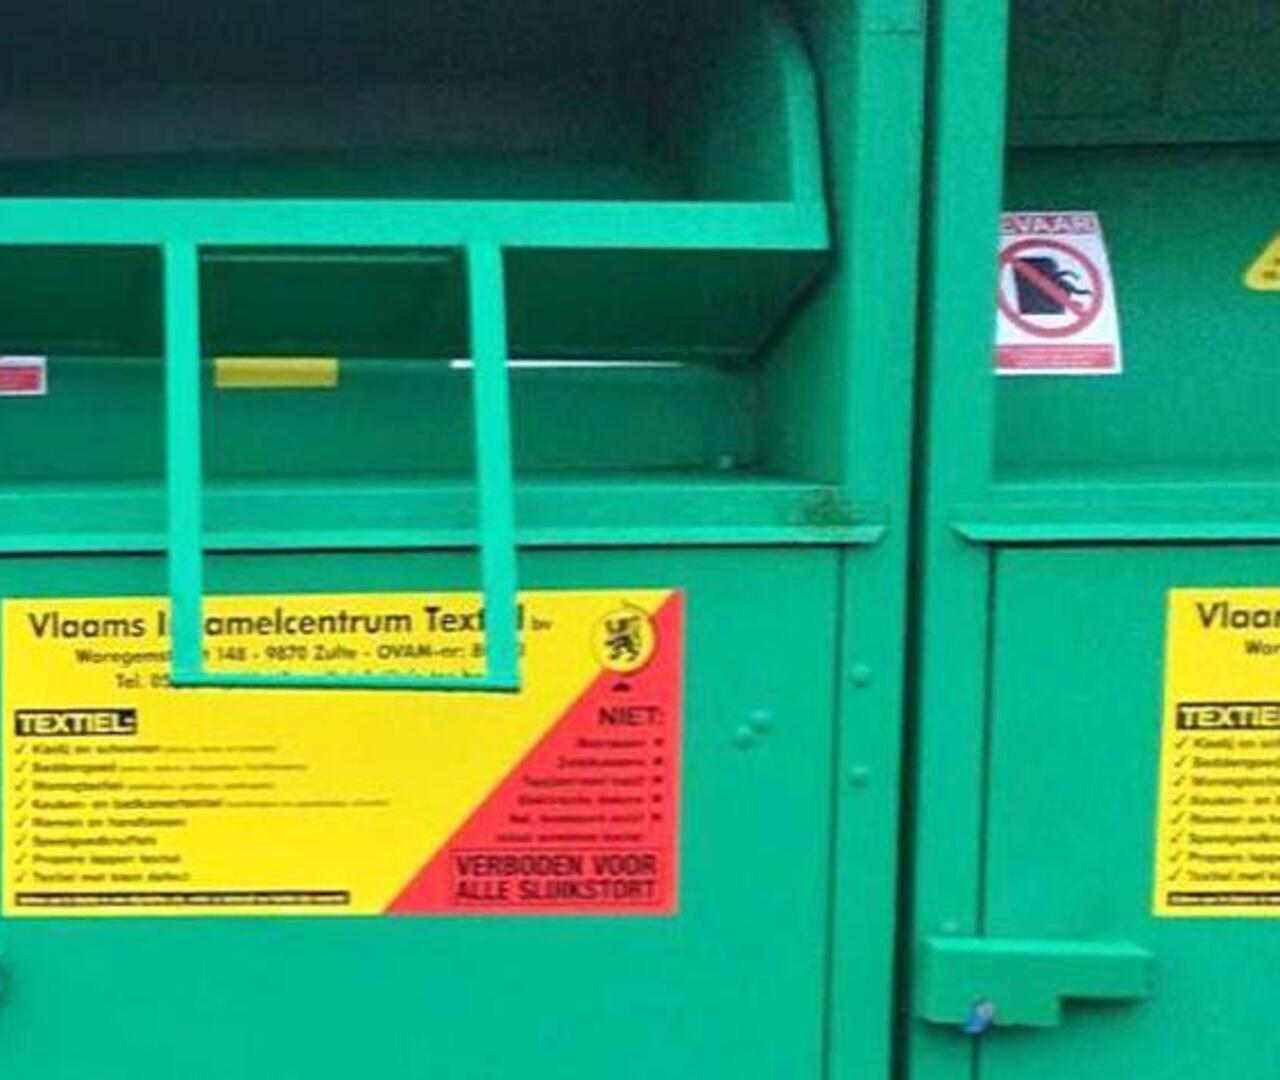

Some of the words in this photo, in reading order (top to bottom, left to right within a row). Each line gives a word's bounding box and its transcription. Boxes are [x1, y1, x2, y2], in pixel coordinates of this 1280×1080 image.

[27, 611, 146, 638] Vlaams
[157, 606, 412, 637] Iamelcentrum
[424, 602, 524, 632] Textl
[1196, 601, 1280, 628] Vlaa
[266, 644, 306, 660] 9870
[598, 705, 666, 726] NIET:
[455, 853, 584, 876] VERBODEN
[593, 853, 657, 876] VOOR
